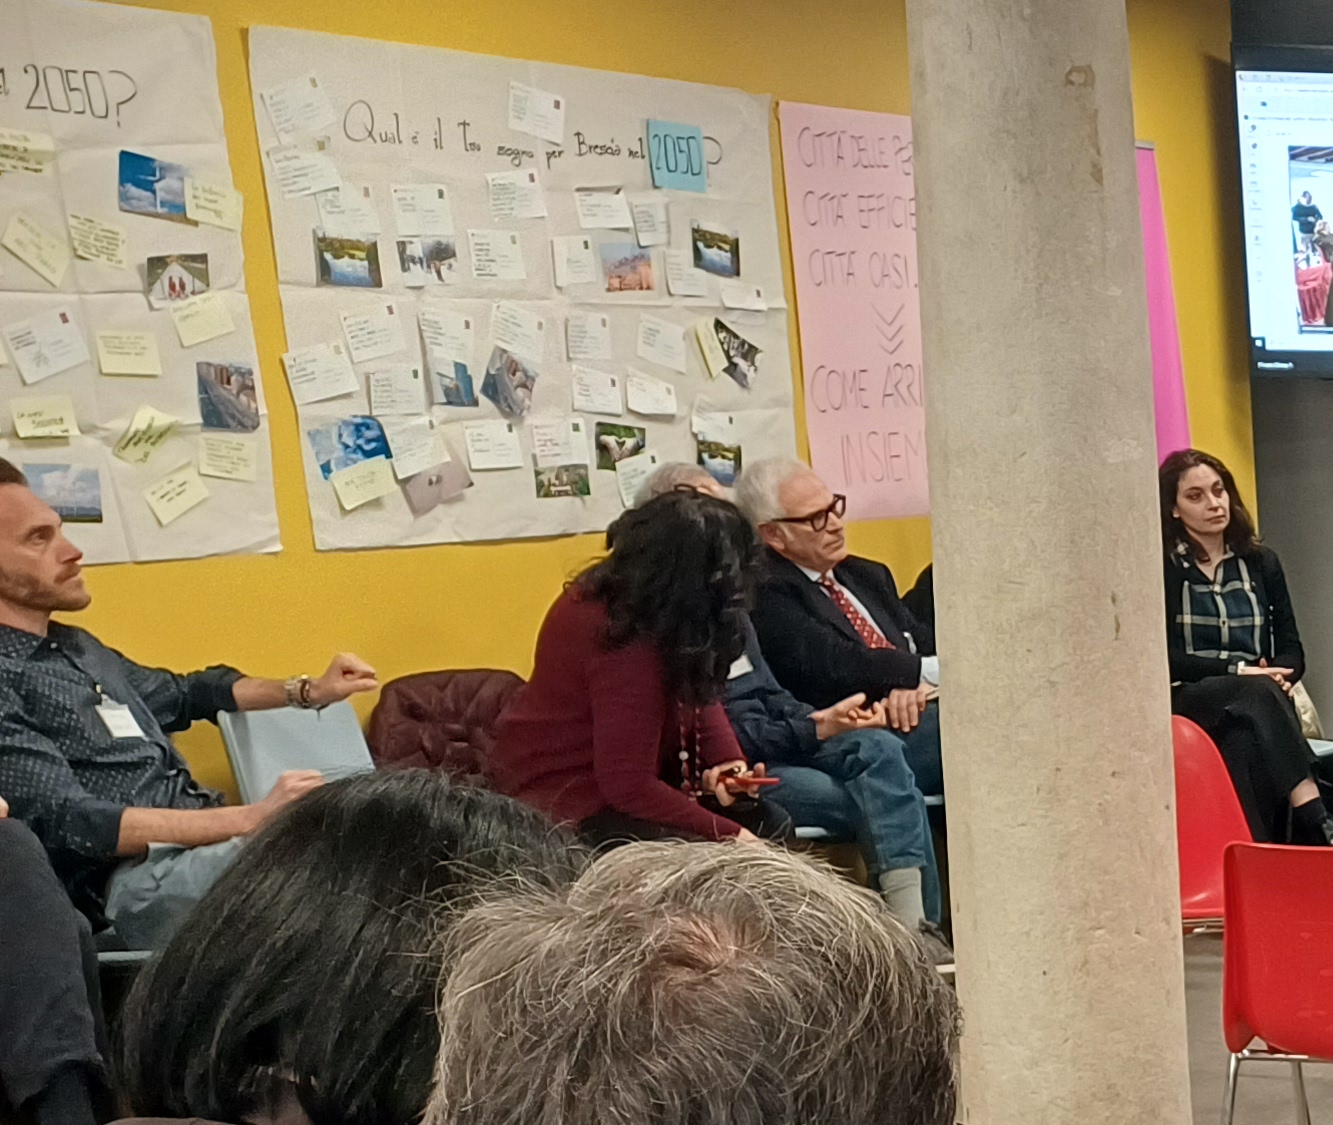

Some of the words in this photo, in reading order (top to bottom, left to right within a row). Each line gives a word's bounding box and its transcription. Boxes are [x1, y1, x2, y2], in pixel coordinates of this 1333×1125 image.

[23, 63, 138, 128] 2050?
[343, 99, 402, 145] Qual
[433, 117, 443, 150] il
[809, 365, 870, 414] COME
